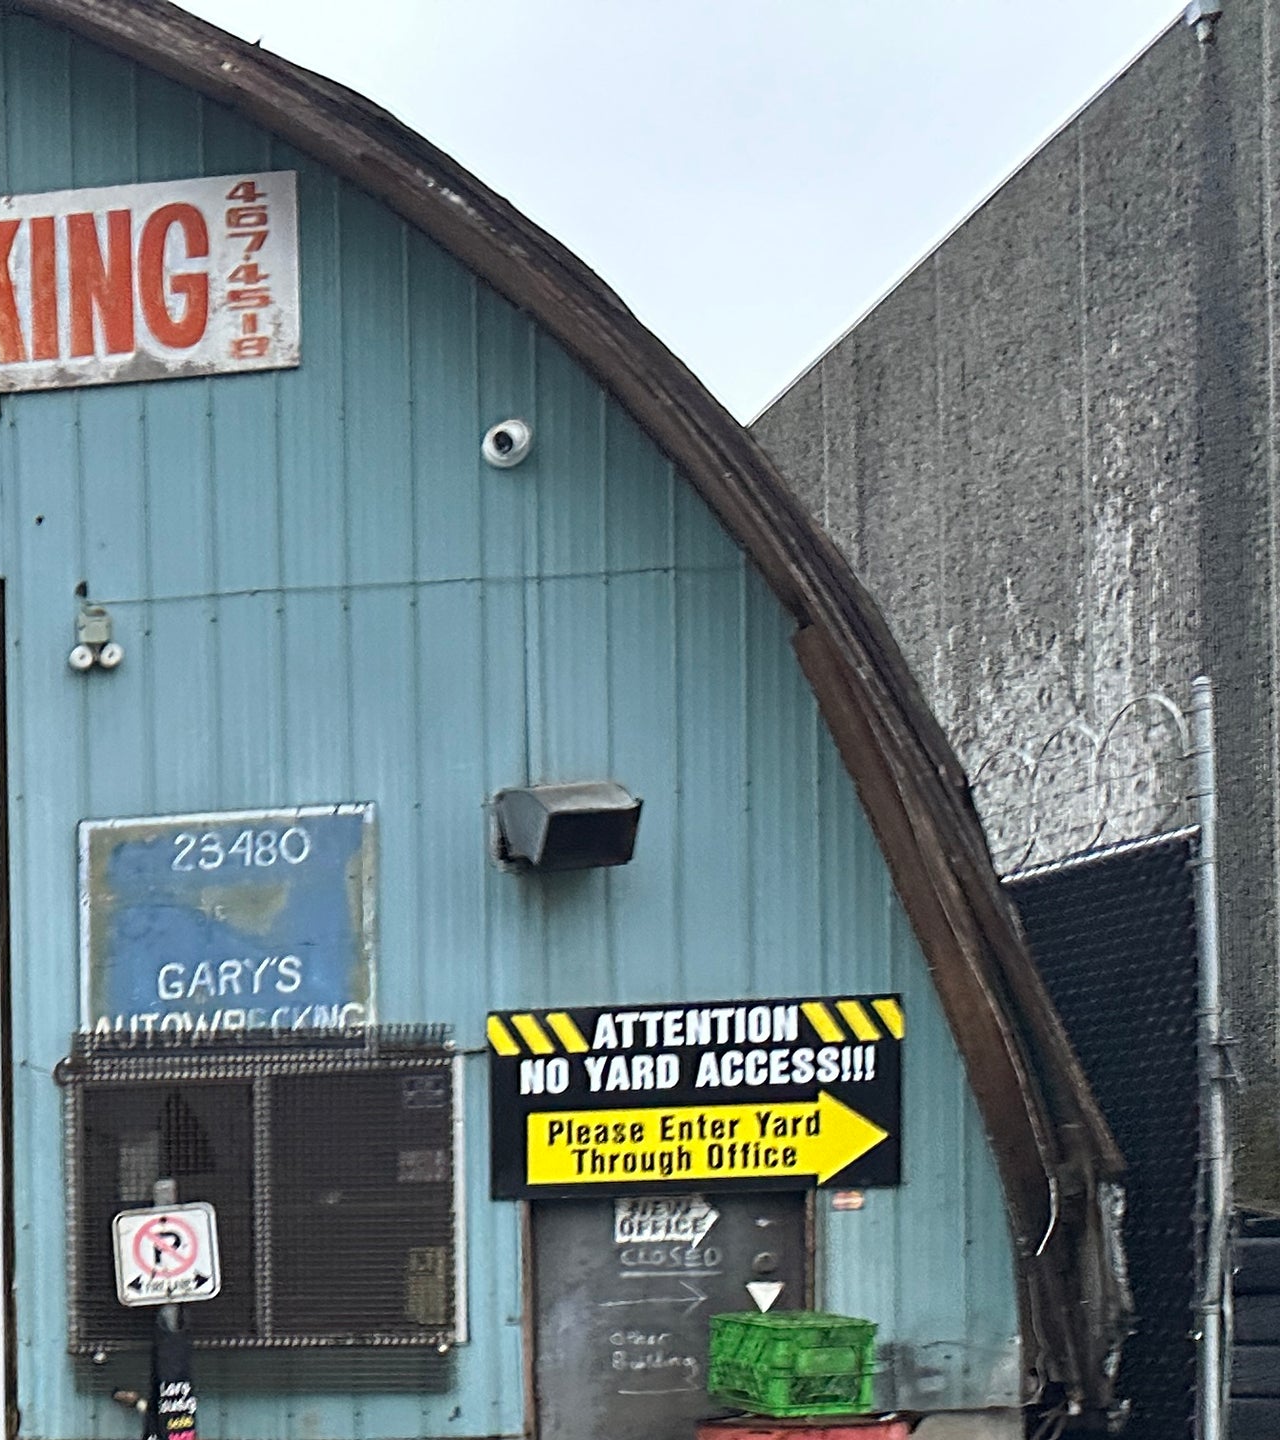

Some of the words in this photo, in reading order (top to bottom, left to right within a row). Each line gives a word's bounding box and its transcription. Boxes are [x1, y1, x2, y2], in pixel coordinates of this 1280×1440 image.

[172, 828, 311, 872] 23480
[158, 956, 302, 1000] GARY'S
[592, 1005, 800, 1049] ATTENTION
[520, 1058, 569, 1095] NO
[584, 1053, 679, 1092] YARD
[695, 1046, 875, 1088] ACCESS!!!
[548, 1118, 644, 1146] Please
[660, 1113, 740, 1141] Enter
[755, 1110, 821, 1139] Yard
[571, 1145, 691, 1177] Through
[707, 1142, 797, 1170] Office
[620, 1215, 706, 1236] OFFICE
[620, 1246, 722, 1267] CLOSED
